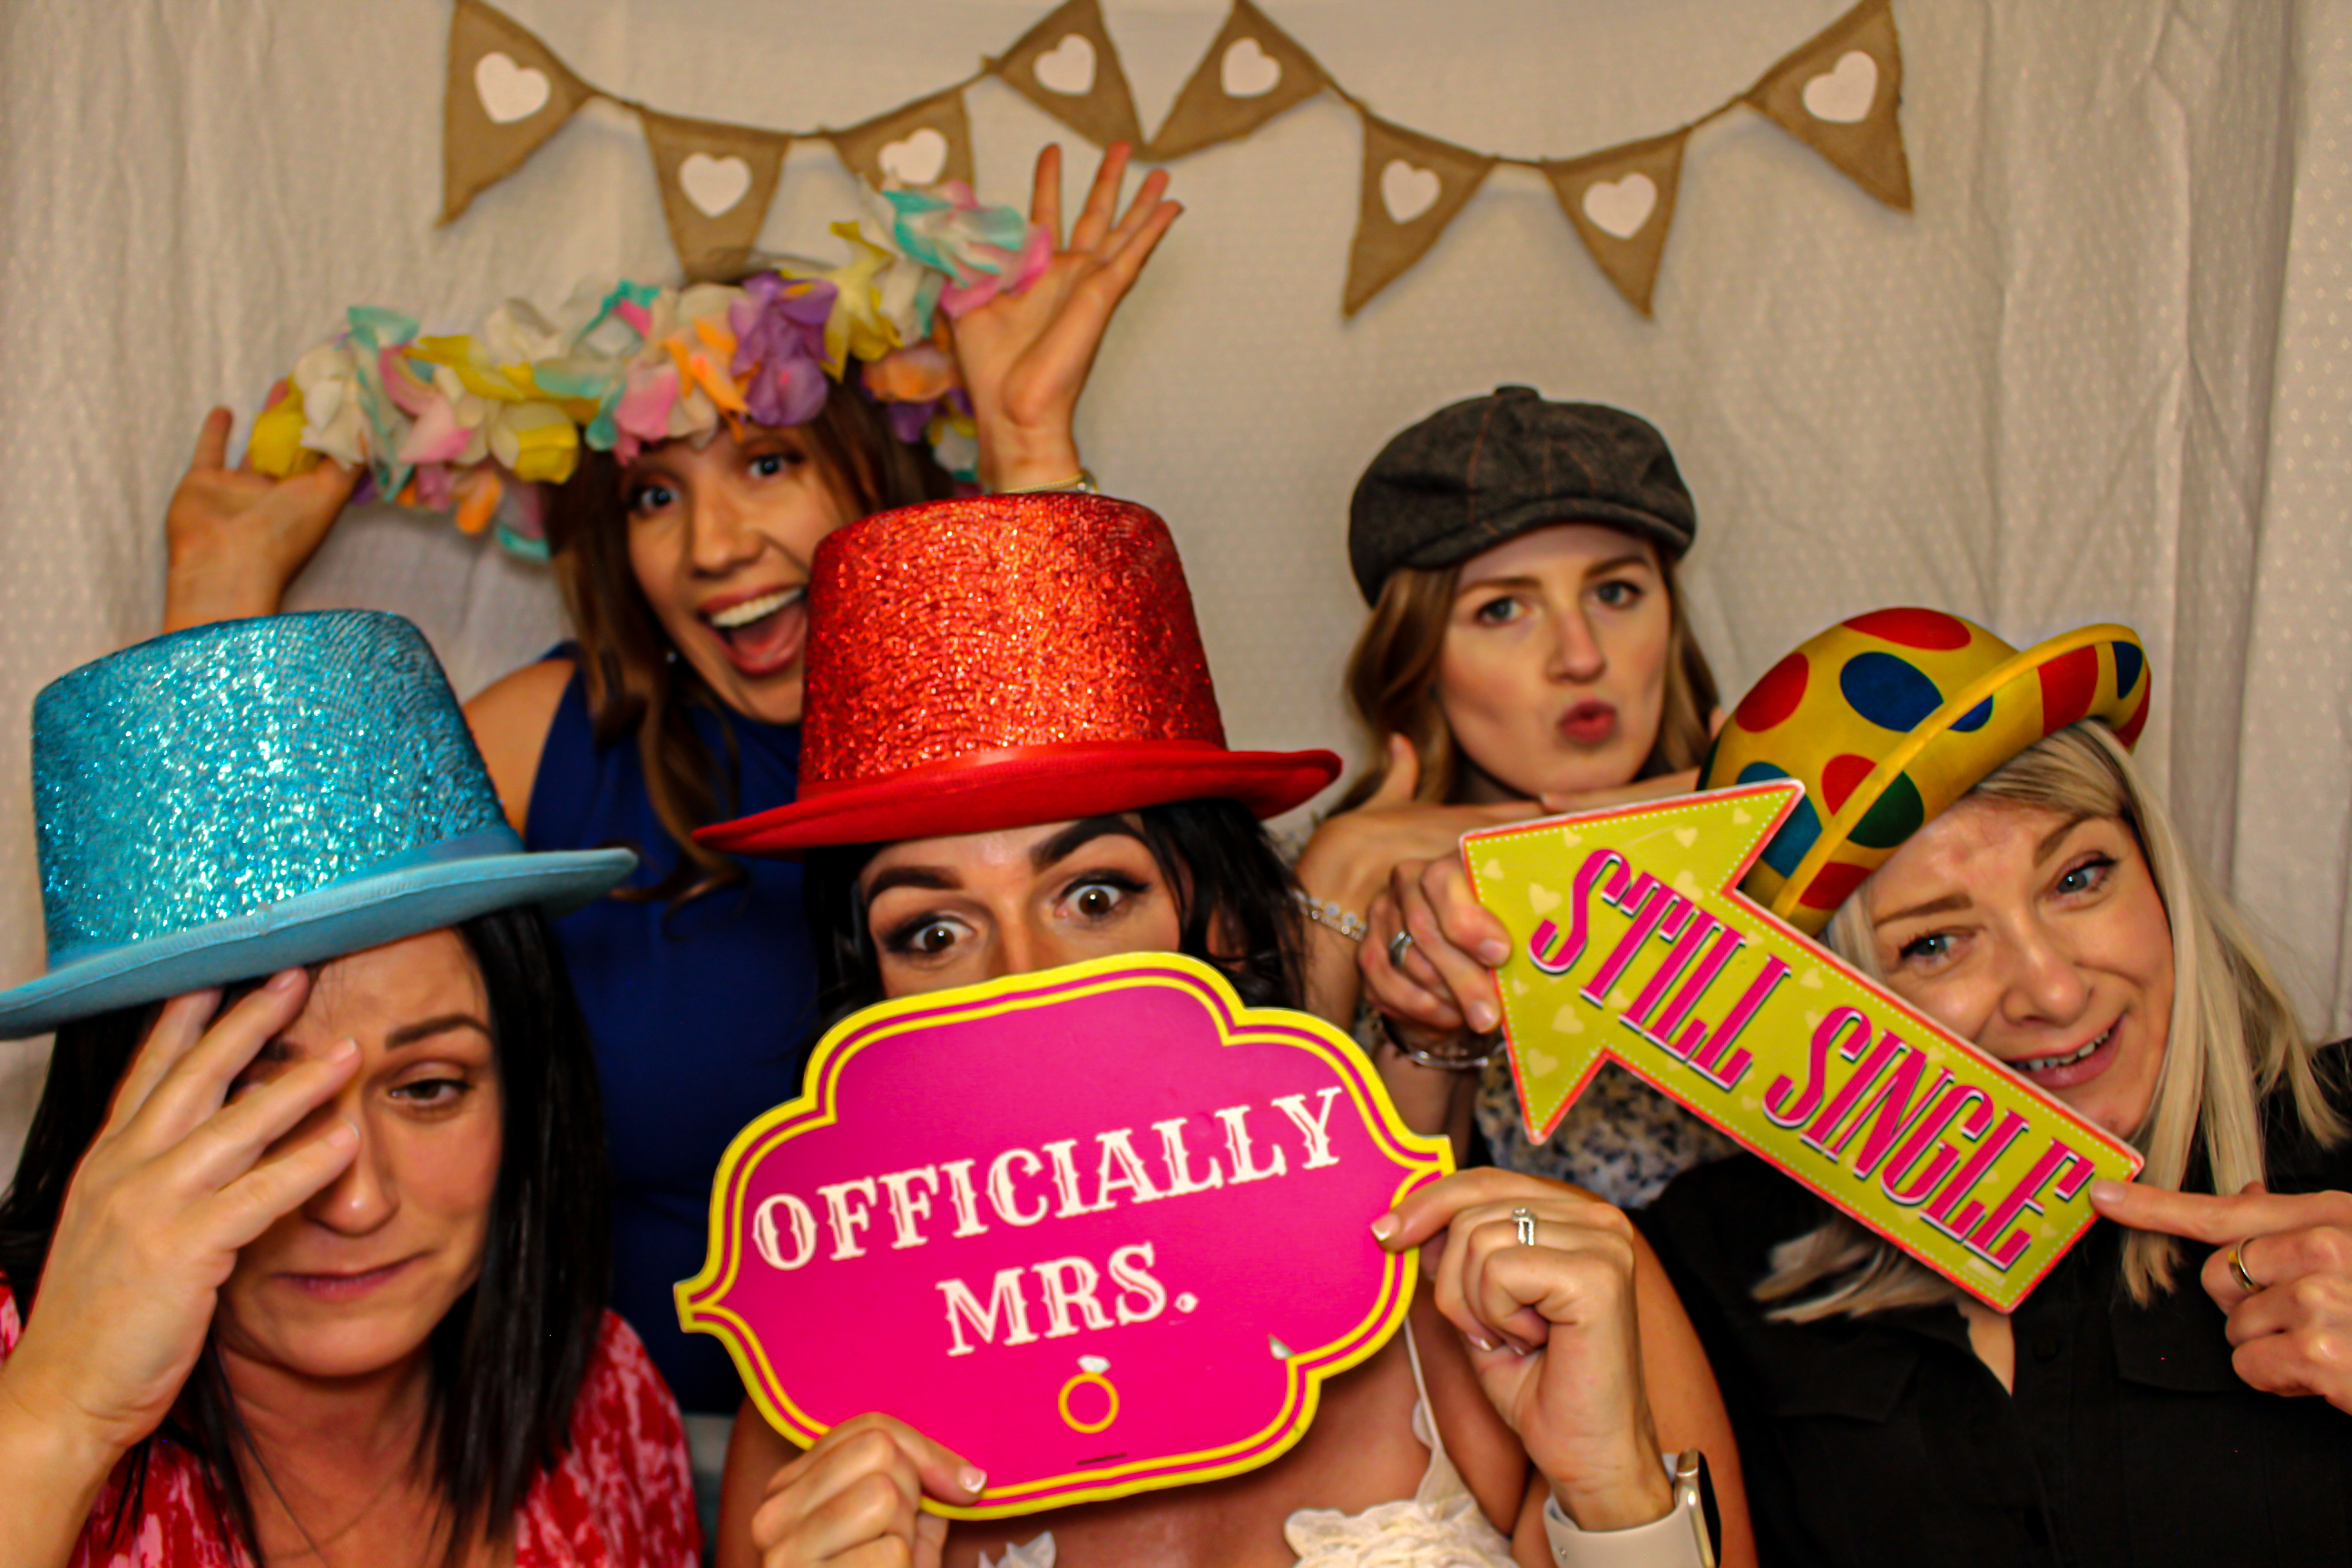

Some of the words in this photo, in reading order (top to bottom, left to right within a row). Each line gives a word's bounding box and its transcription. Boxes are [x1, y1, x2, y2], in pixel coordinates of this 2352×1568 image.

[1528, 848, 1791, 1091] STILL
[1762, 1006, 2096, 1271] SINGLE
[751, 1087, 1342, 1270] OFFICIALLY
[936, 1241, 1199, 1357] MRS.
